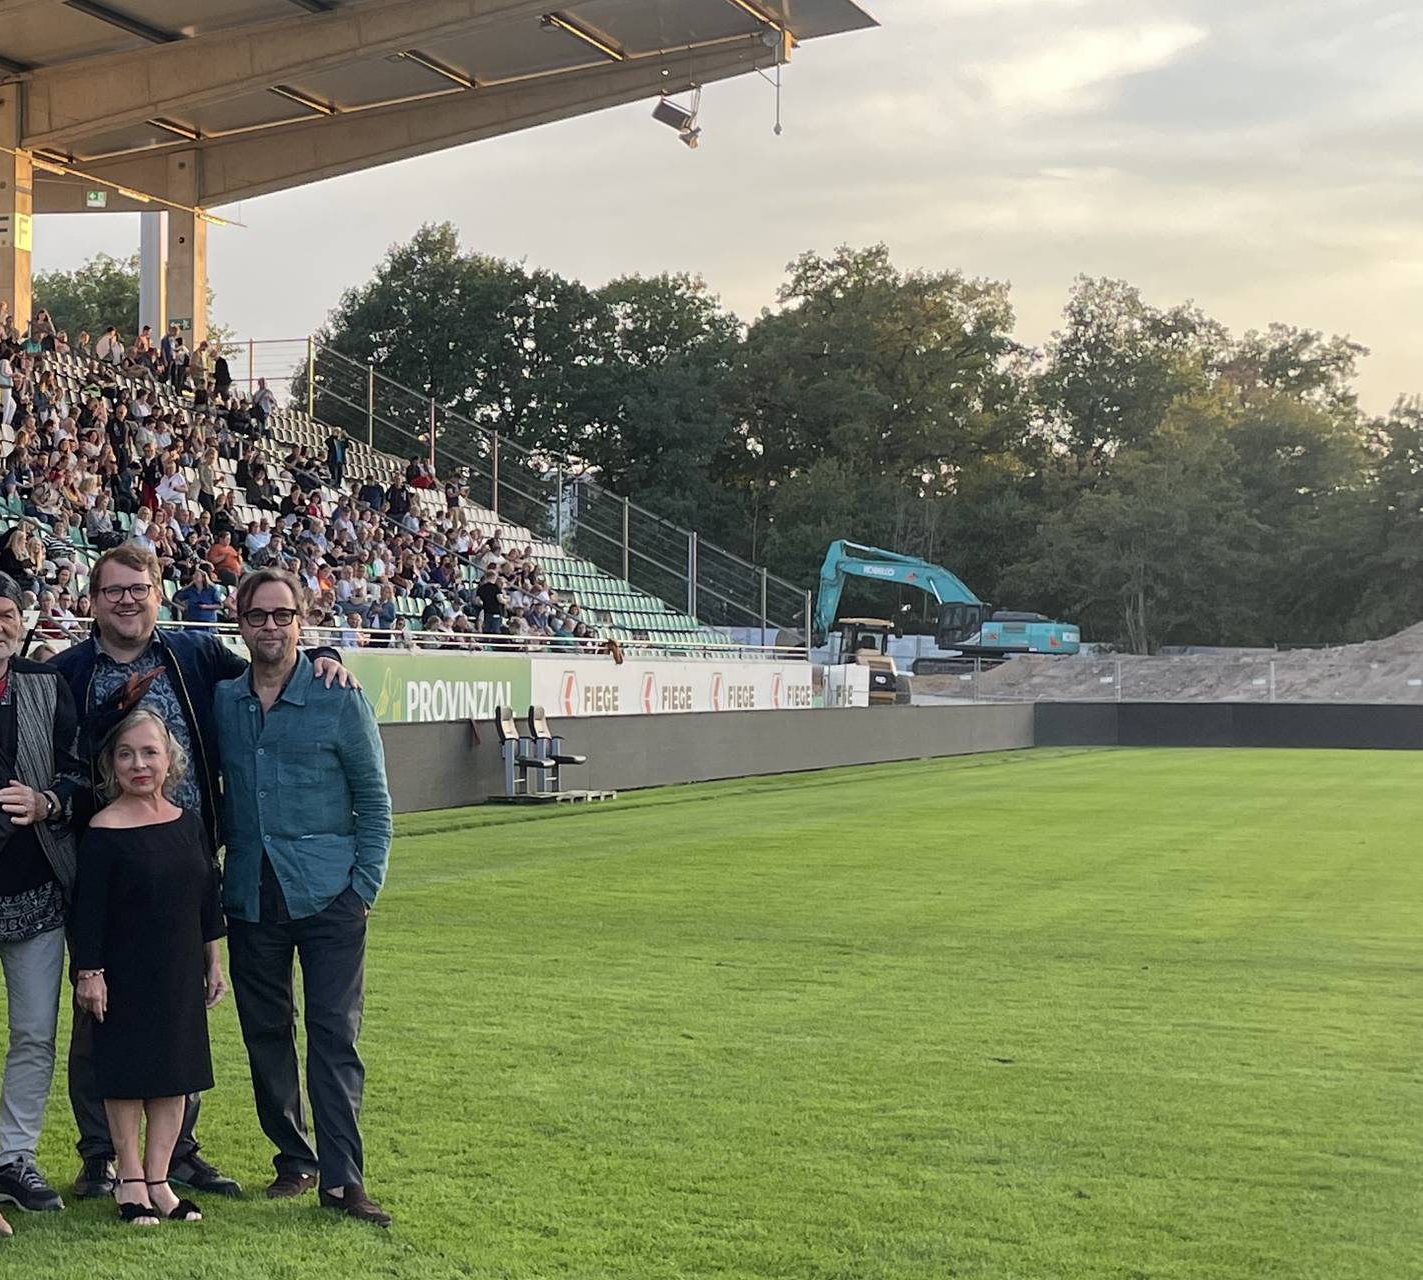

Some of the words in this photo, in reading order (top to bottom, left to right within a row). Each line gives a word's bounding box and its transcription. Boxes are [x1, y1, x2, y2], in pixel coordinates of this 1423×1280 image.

[584, 686, 619, 712] FIEGE
[662, 686, 692, 710] FIEGE
[728, 686, 755, 708] FIEGE
[787, 685, 811, 706] FIEGE
